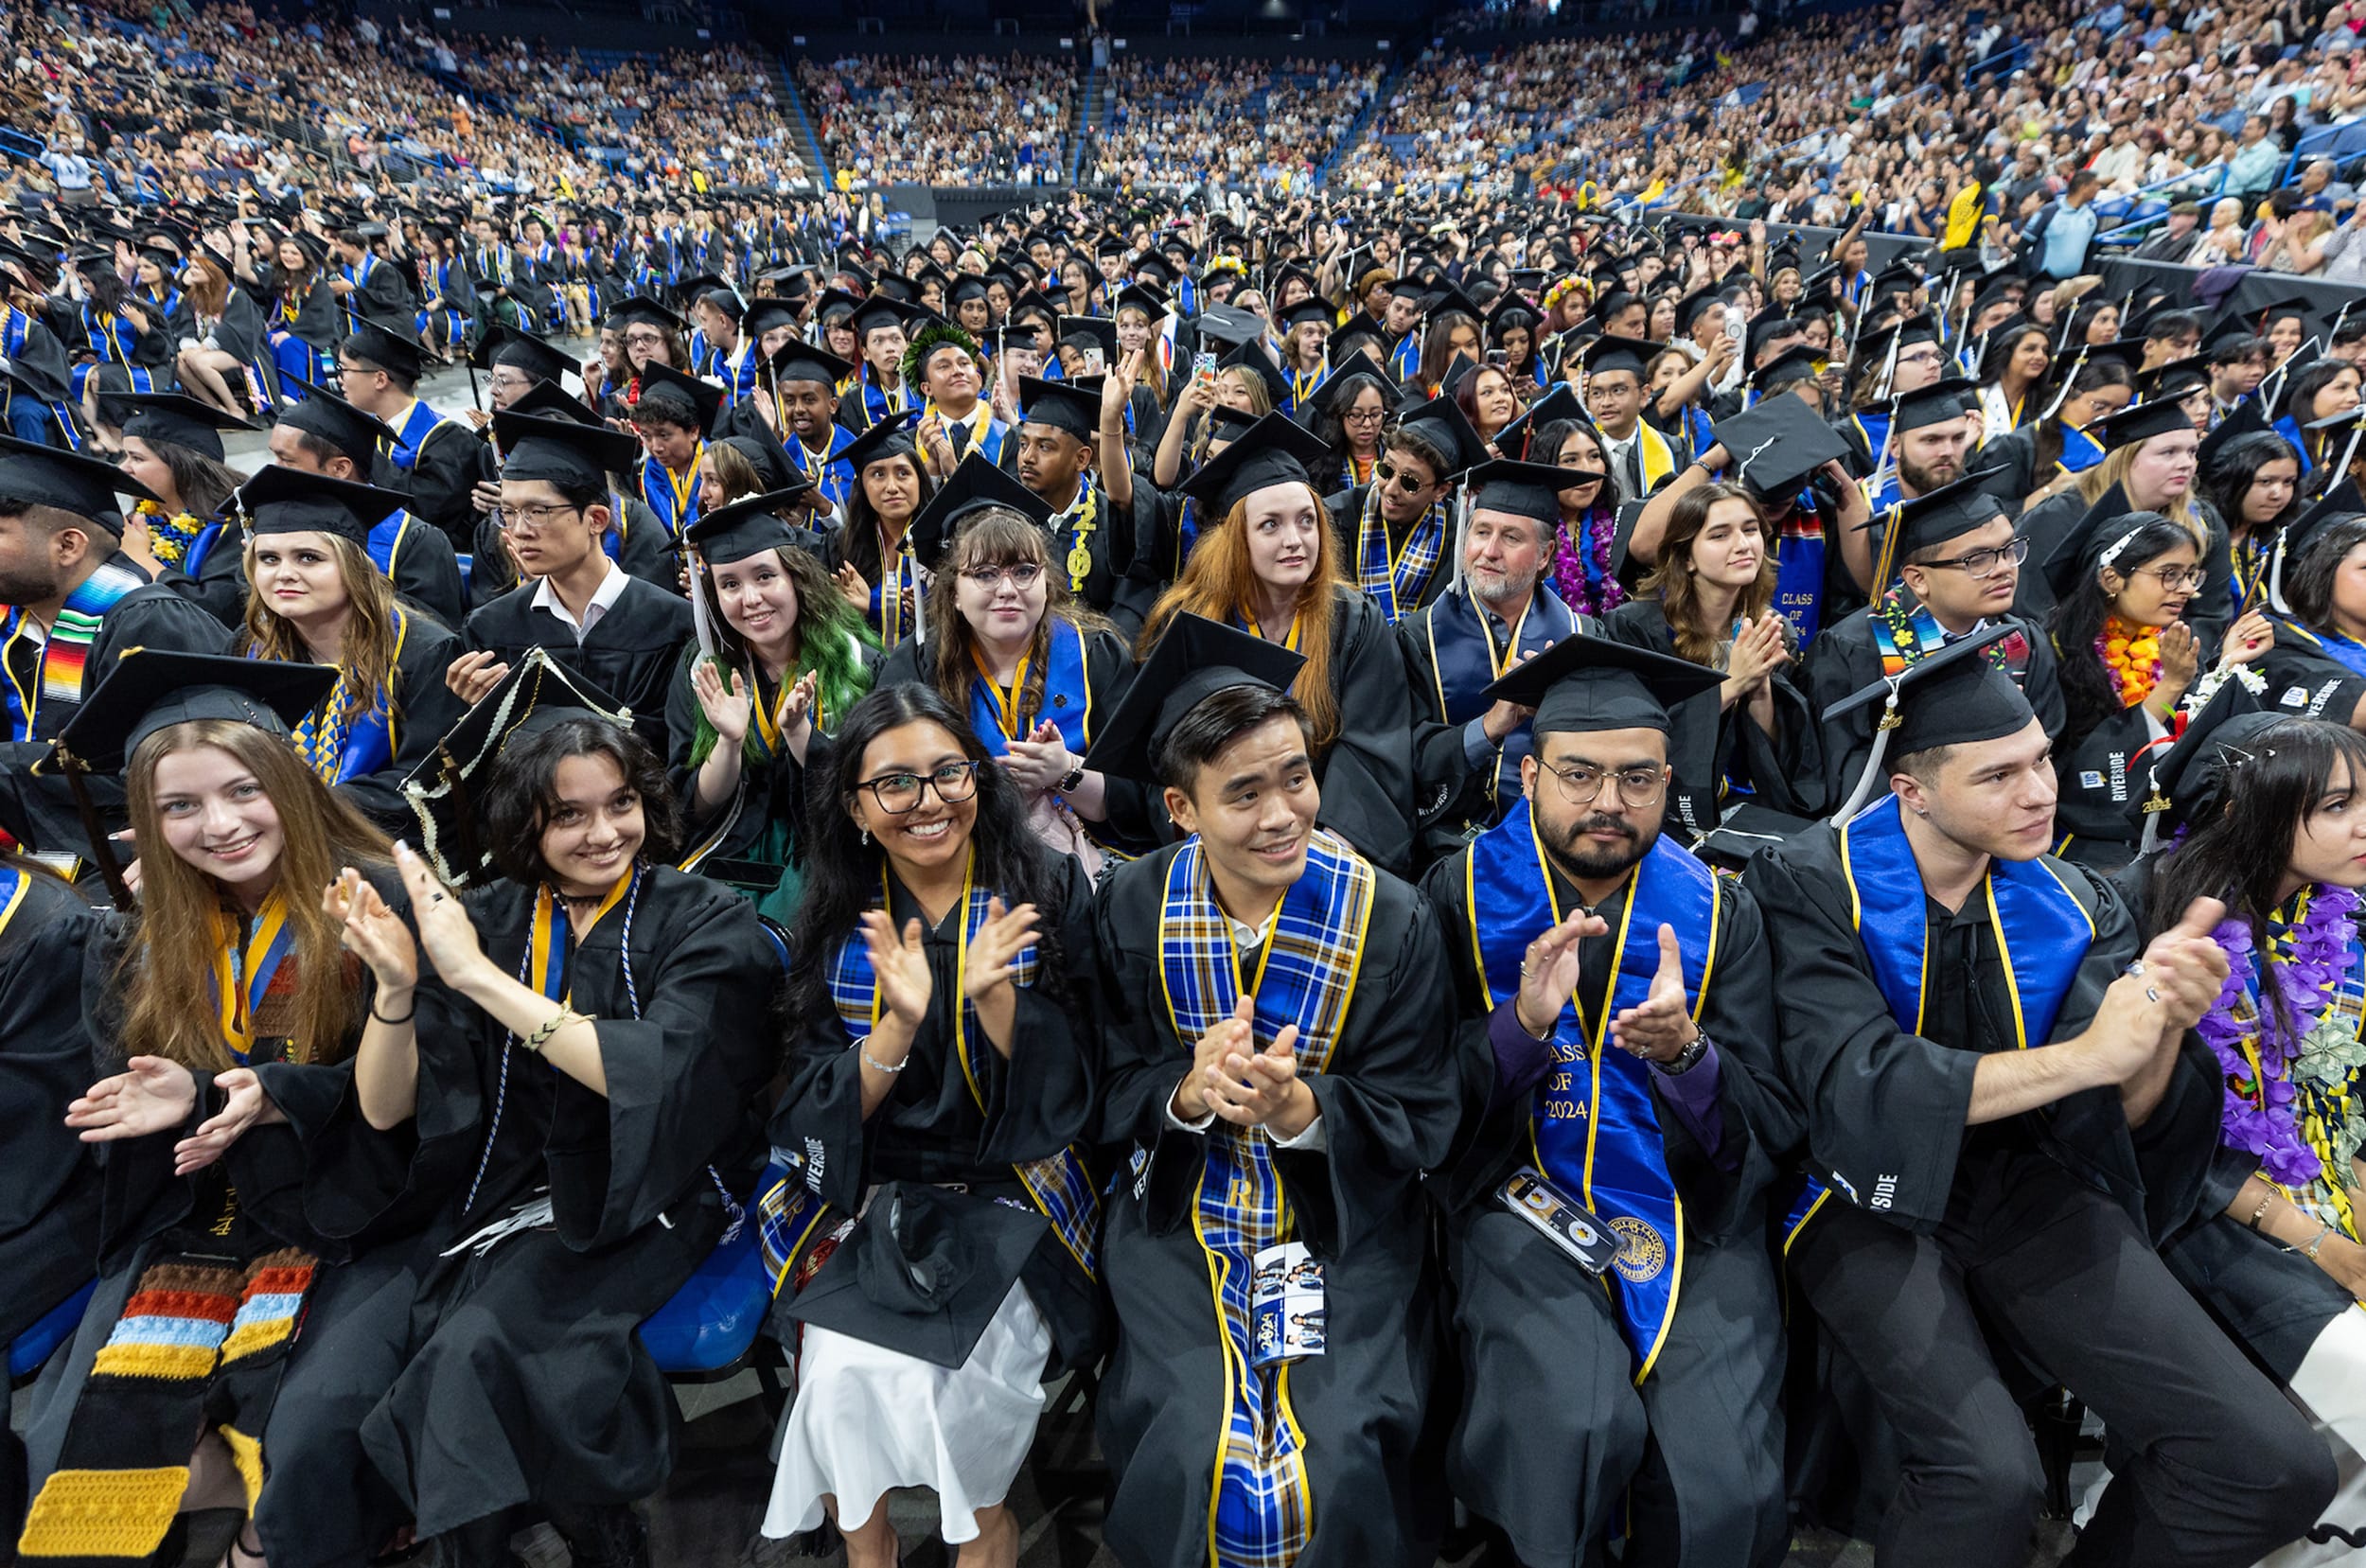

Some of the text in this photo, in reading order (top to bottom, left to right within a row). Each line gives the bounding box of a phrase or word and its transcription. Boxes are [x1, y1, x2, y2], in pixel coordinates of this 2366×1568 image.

[1781, 592, 1813, 606] CLASS
[1790, 610, 1803, 621] OF
[2109, 751, 2128, 802] RIVERSIDE
[1545, 1100, 1588, 1119] 2024
[1227, 1179, 1253, 1210] R
[1261, 1312, 1275, 1351] 2024
